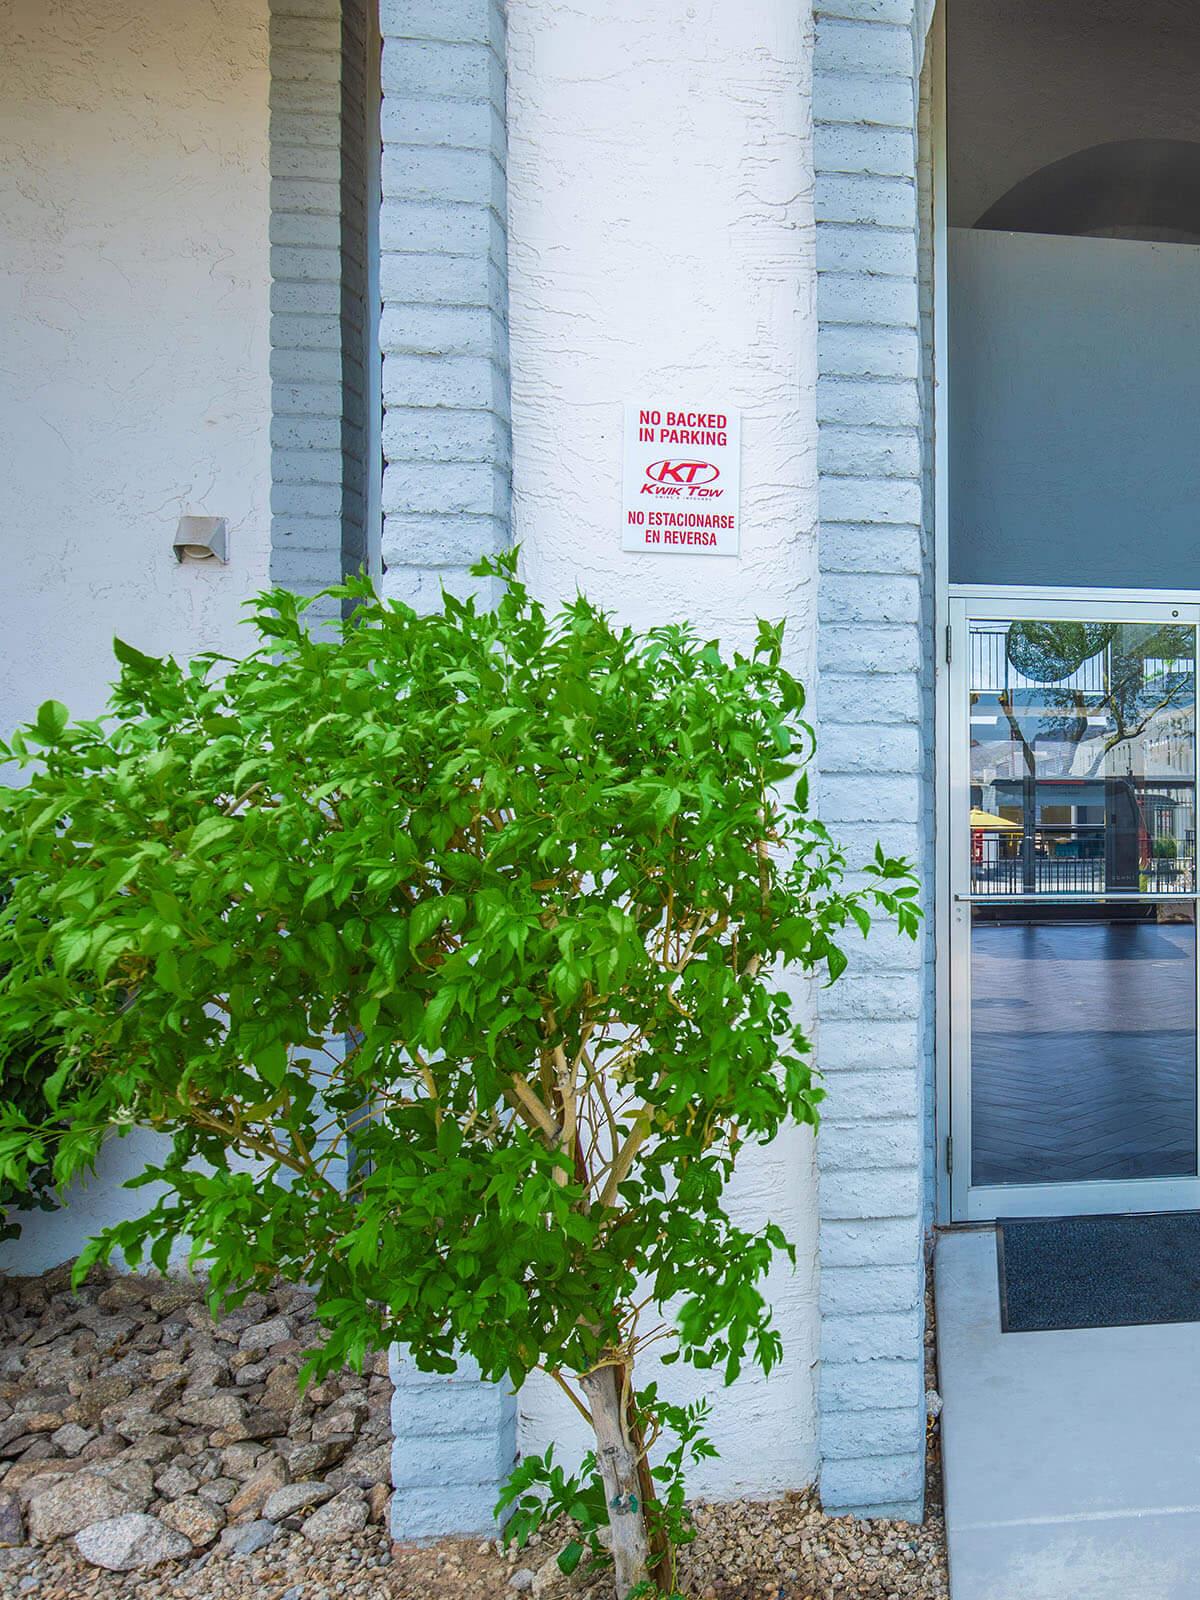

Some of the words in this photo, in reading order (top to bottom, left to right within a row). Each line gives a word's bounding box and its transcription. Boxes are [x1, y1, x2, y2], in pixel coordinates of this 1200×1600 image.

[639, 410, 661, 426] NO
[666, 411, 727, 429] BACKED
[639, 427, 654, 442] IN
[660, 428, 727, 446] PARKING
[657, 461, 708, 483] KT
[628, 511, 645, 525] NO
[648, 511, 735, 529] ESTACIONARSE
[645, 529, 660, 544] EN
[664, 530, 717, 546] REVERSA
